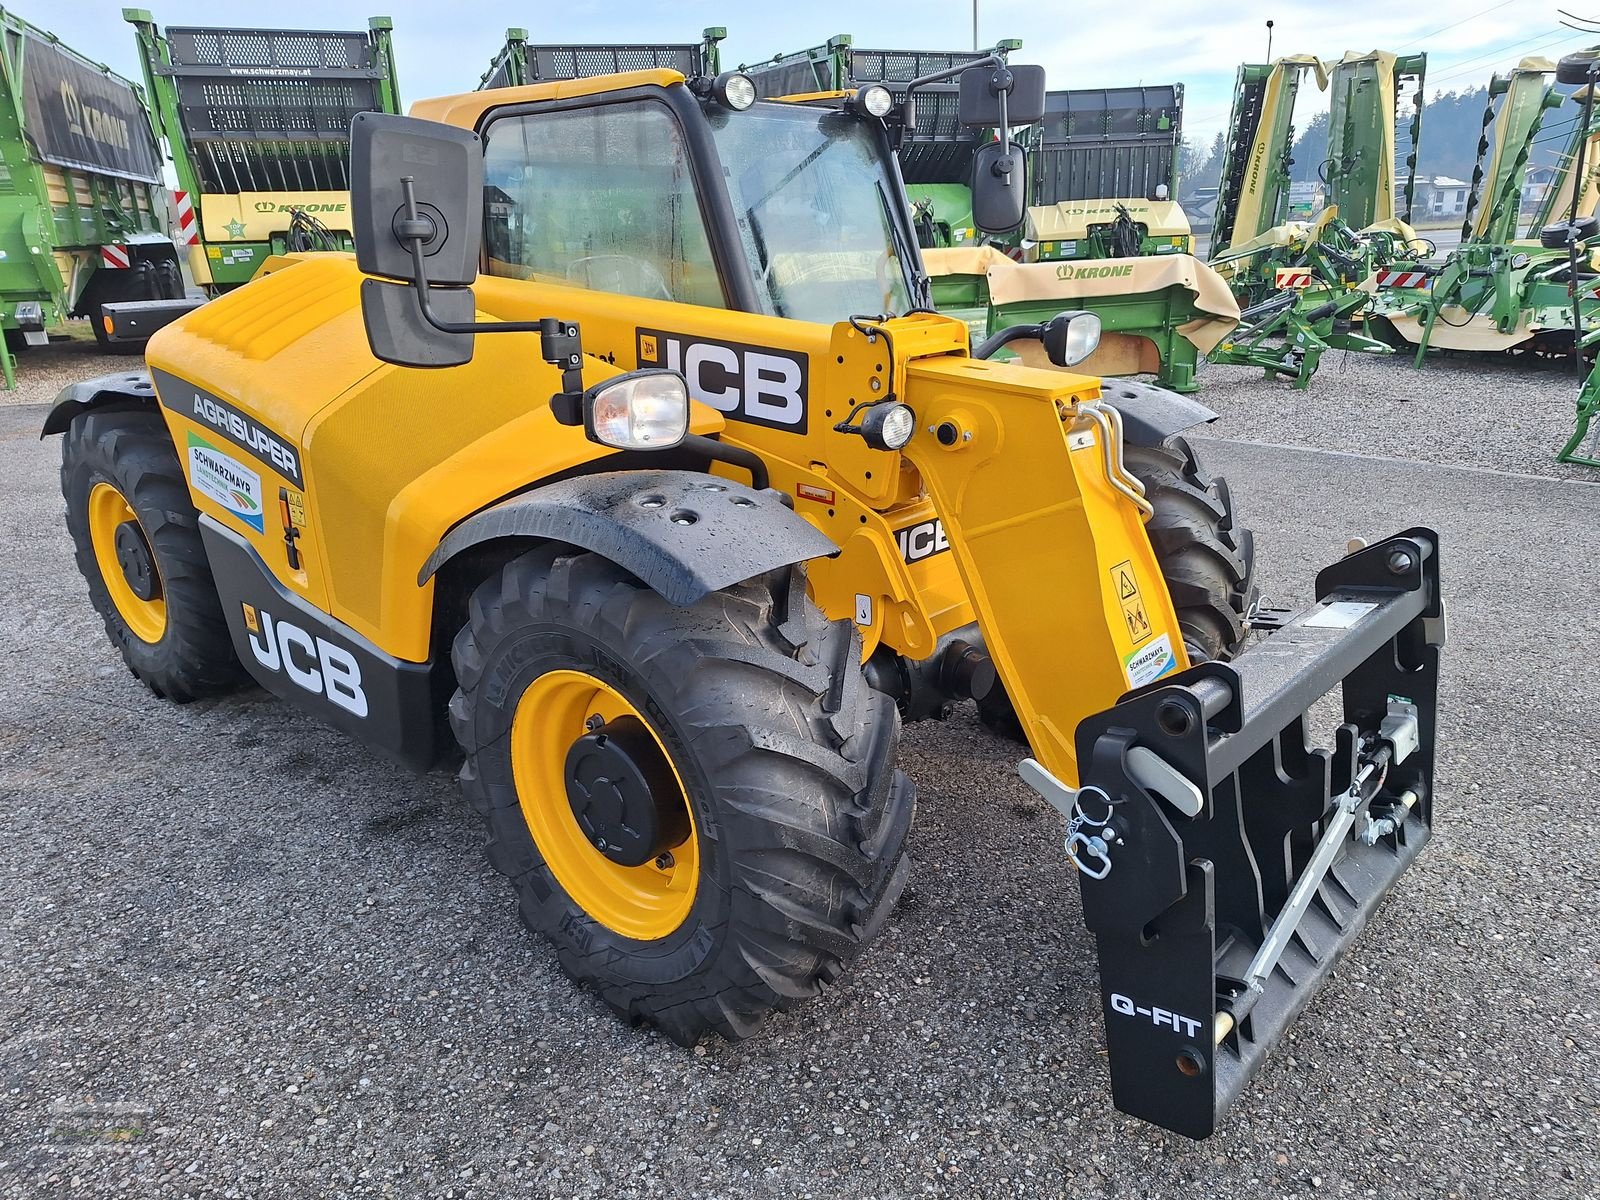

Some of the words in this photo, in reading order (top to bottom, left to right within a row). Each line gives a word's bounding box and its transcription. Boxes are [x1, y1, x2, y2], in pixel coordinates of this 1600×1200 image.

[230, 67, 311, 77] www.schwarzmayr.at
[82, 104, 129, 150] KRONE
[1249, 154, 1262, 196] KRONE
[1086, 207, 1149, 215] KRNE
[1074, 265, 1133, 279] KRONE
[193, 393, 298, 479] AGRISUPER
[194, 448, 251, 495] SCHWARZMAYR
[248, 610, 369, 718] JCB
[1129, 646, 1164, 672] SCHWARZMAYR
[1110, 993, 1202, 1038] Q-FIT
